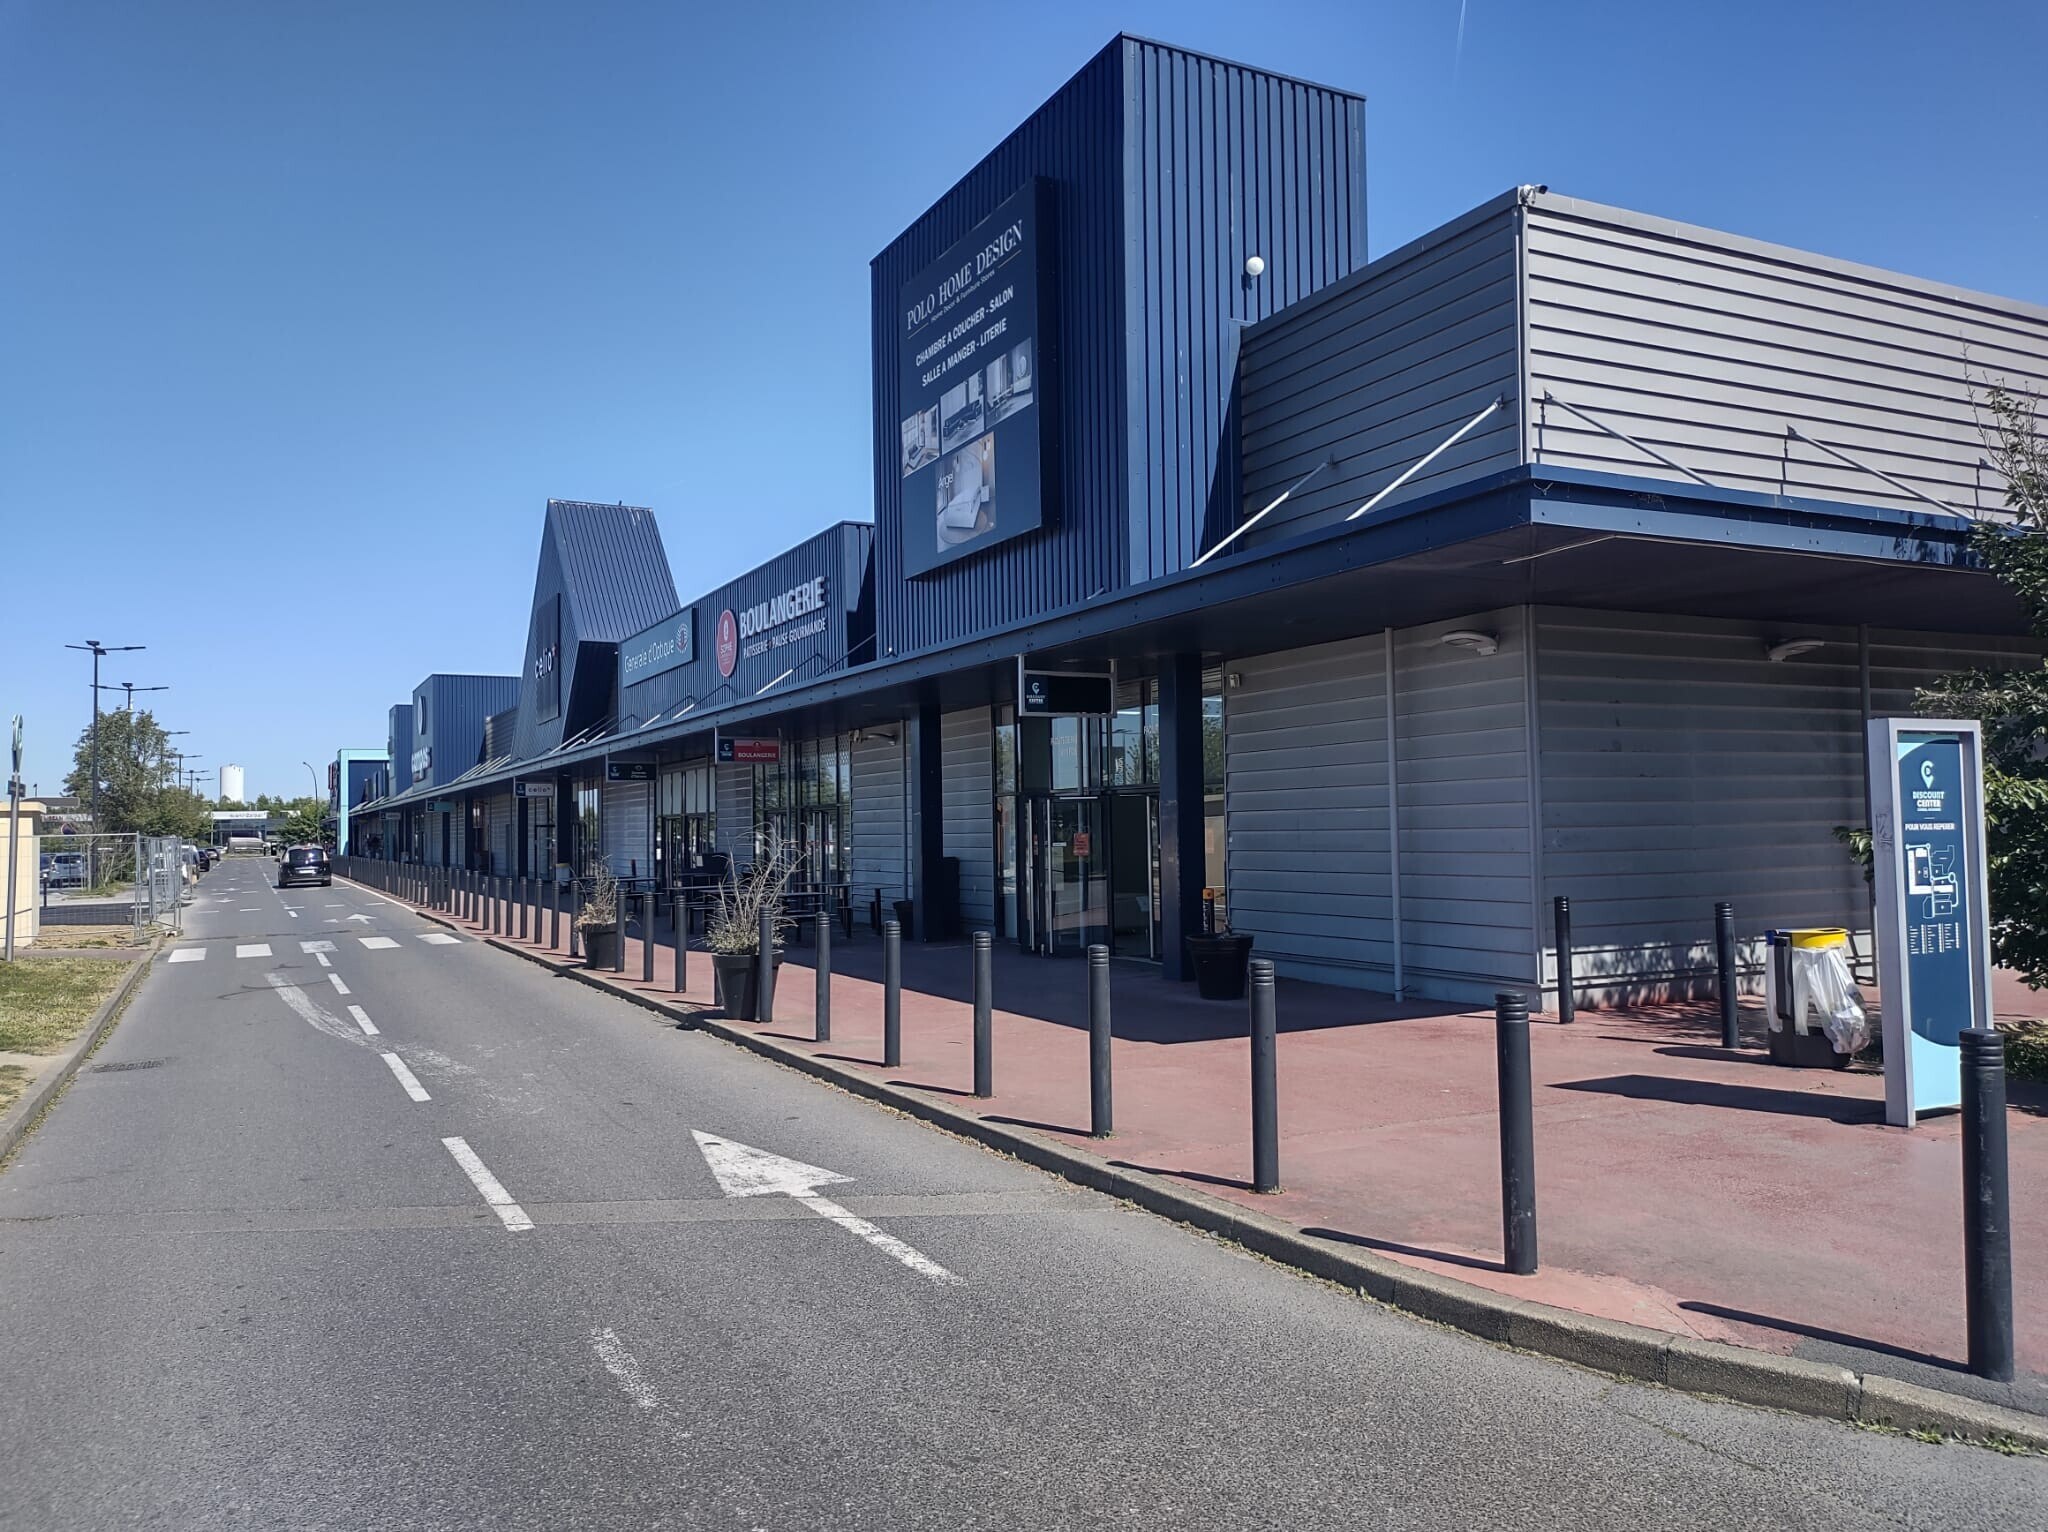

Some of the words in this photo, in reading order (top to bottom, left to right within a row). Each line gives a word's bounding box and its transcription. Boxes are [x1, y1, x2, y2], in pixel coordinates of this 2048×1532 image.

[907, 293, 935, 331] POLO
[939, 262, 972, 305] HOME
[976, 219, 1023, 276] DESIGN
[915, 335, 947, 367] CHAMBRE
[947, 331, 952, 344] A
[952, 307, 985, 340] COUCHER
[989, 285, 1014, 313] SALON
[922, 364, 941, 387] SALLE
[942, 361, 947, 374] A
[947, 340, 976, 371] MANGER
[980, 317, 1007, 347] LITERIE
[740, 576, 826, 640] BOULANGERIE
[789, 617, 827, 643] GOURMANDE
[1912, 791, 1945, 799] DISCOUNT
[1916, 799, 1942, 808] CENTER
